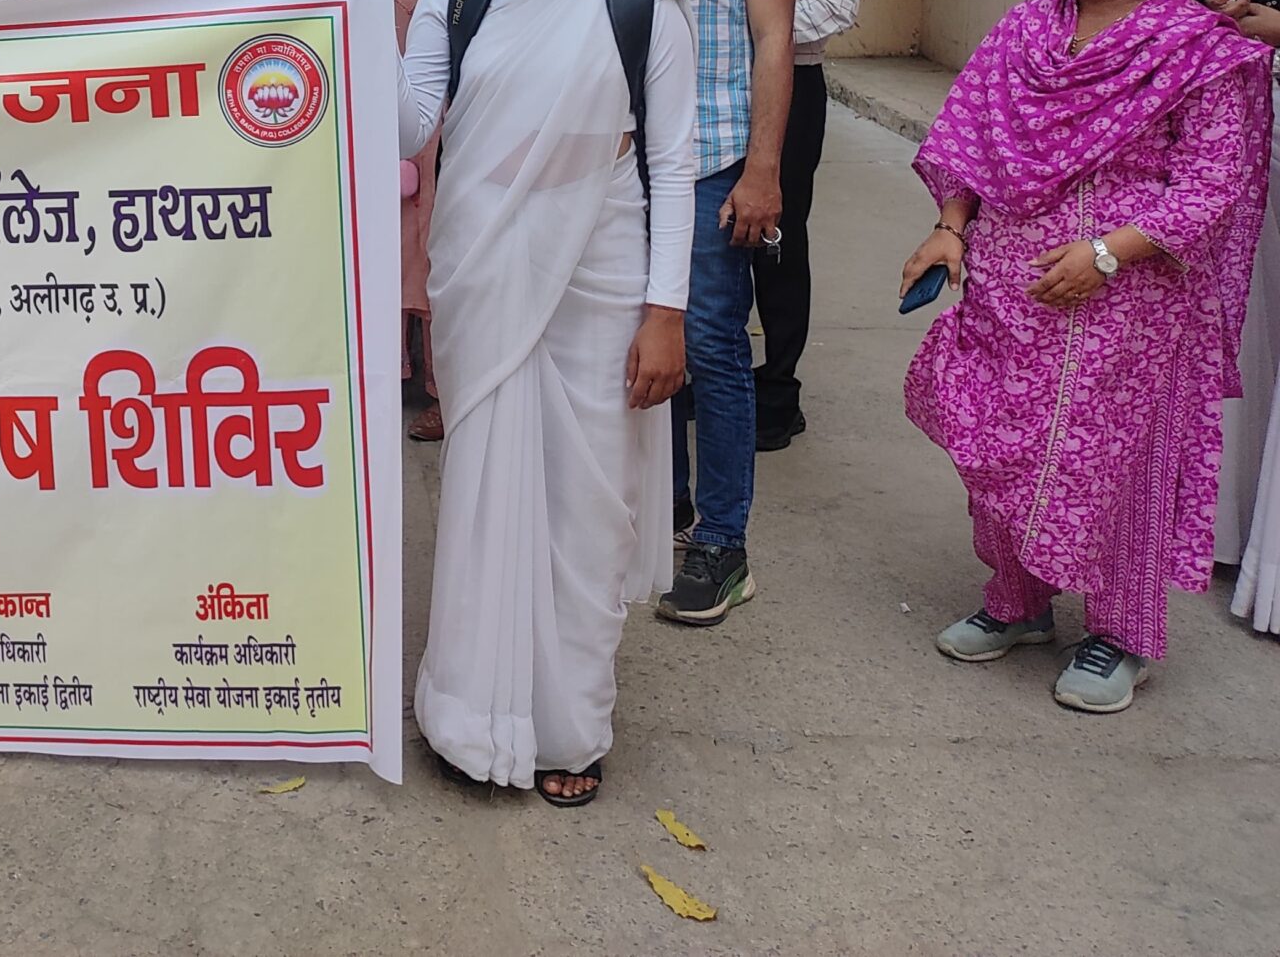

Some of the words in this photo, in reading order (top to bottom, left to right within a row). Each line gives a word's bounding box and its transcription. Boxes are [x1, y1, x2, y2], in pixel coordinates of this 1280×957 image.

[239, 119, 261, 135] BAGLA
[109, 185, 272, 252] हाथरस
[9, 272, 96, 324] अलीगढ़
[79, 346, 330, 489] शिविर
[195, 582, 269, 621] अंकिता
[172, 635, 229, 666] कार्यक्रम
[234, 635, 296, 666] अधिकारी
[13, 675, 49, 712] इकाई
[52, 675, 93, 710] द्वितीय
[133, 677, 178, 716] राष्ट्रीय
[182, 677, 211, 709] सेवा
[214, 678, 259, 708] योजना
[262, 677, 300, 716] इकाई
[304, 678, 342, 718] तृतीय
